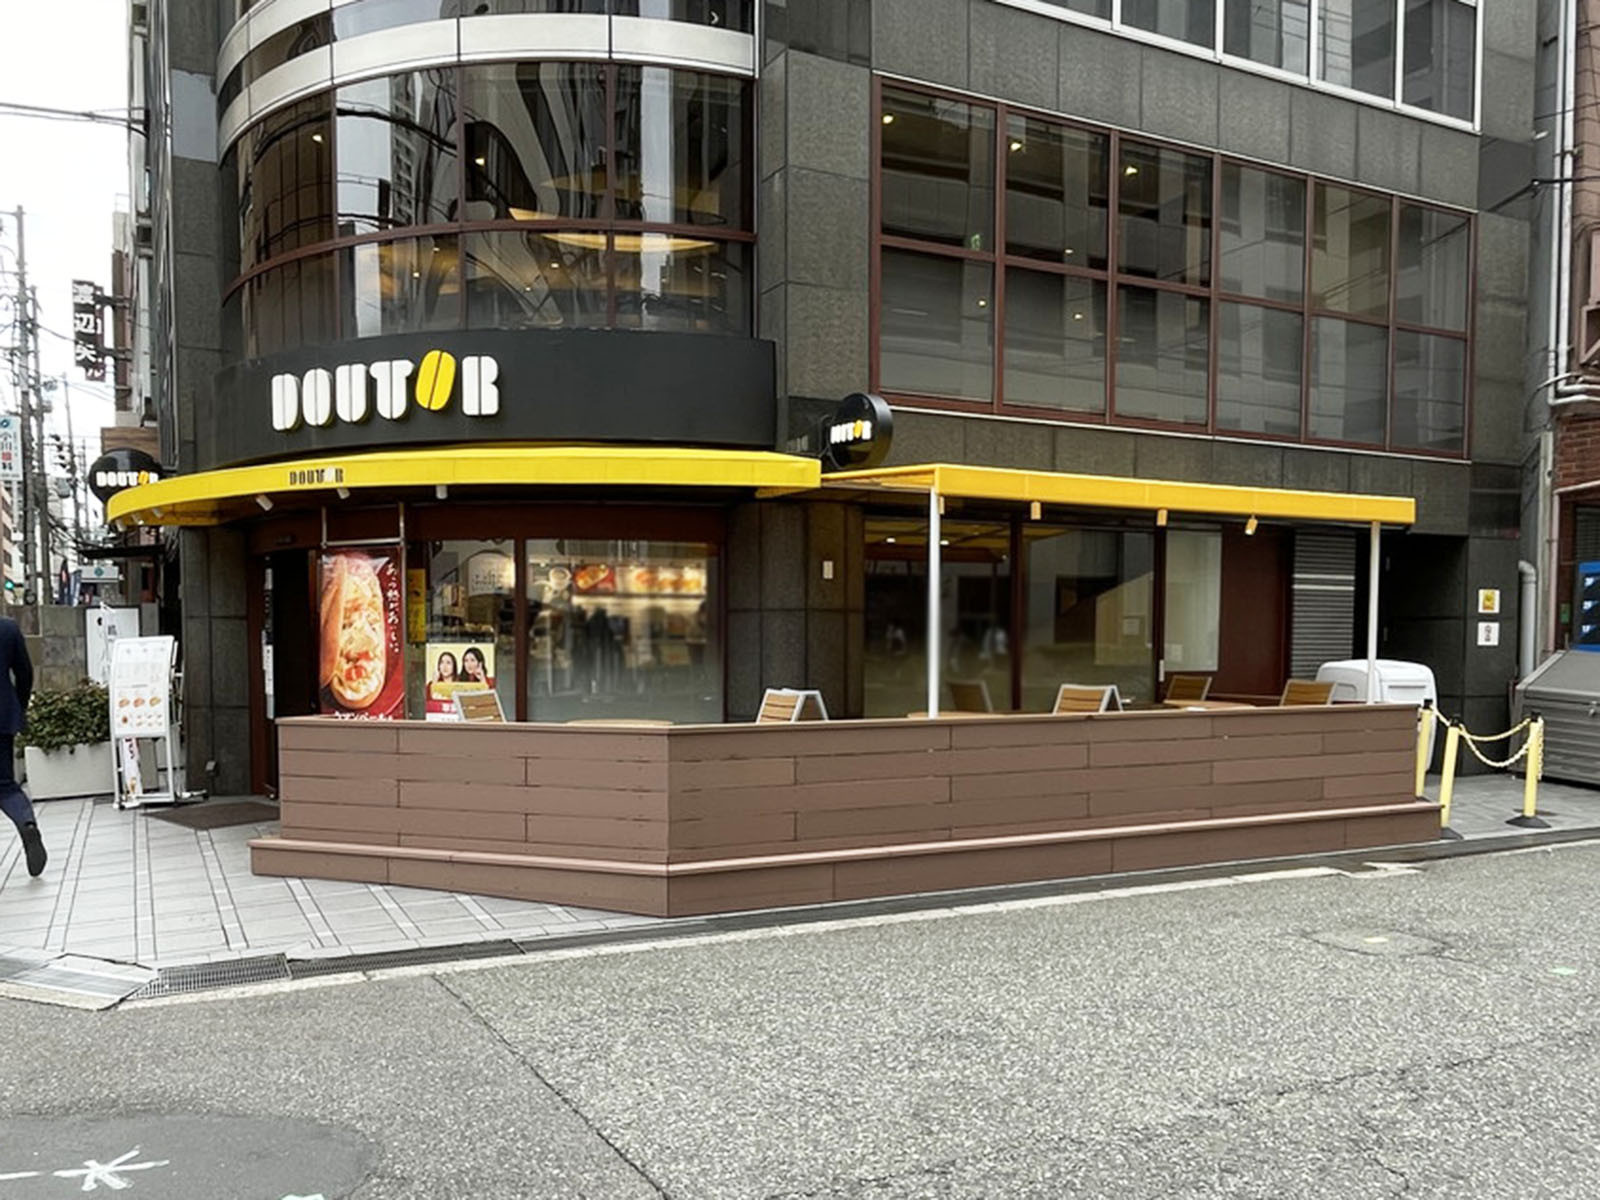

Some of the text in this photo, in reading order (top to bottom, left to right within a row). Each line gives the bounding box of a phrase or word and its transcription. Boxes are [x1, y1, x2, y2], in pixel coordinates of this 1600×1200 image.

[271, 349, 500, 431] DOUTOR
[830, 419, 872, 445] DOUTOR
[96, 470, 159, 487] DOUTOR
[289, 467, 344, 486] DOUTOR
